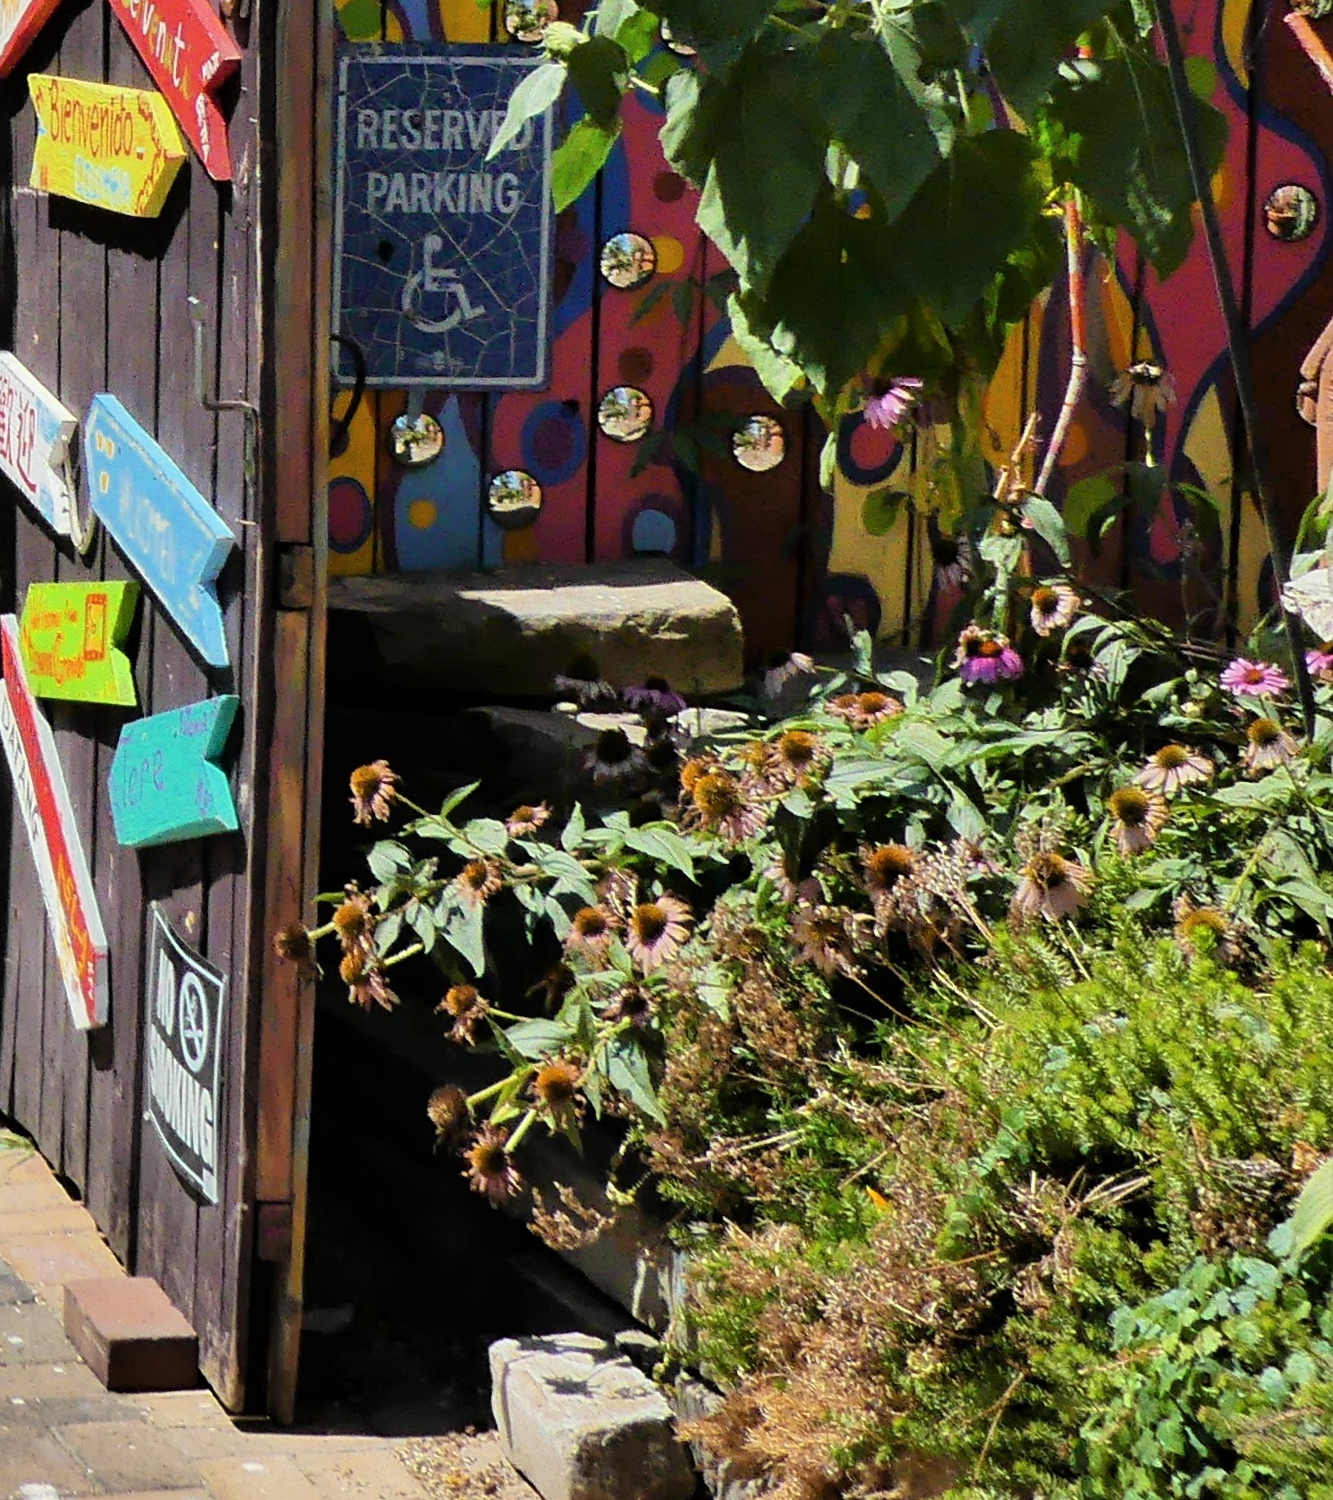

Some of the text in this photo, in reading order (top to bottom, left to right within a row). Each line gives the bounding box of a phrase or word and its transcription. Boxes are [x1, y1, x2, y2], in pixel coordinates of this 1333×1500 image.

[367, 172, 522, 214] PARKING
[156, 947, 176, 1037] NO
[149, 1021, 214, 1174] SMOKING
